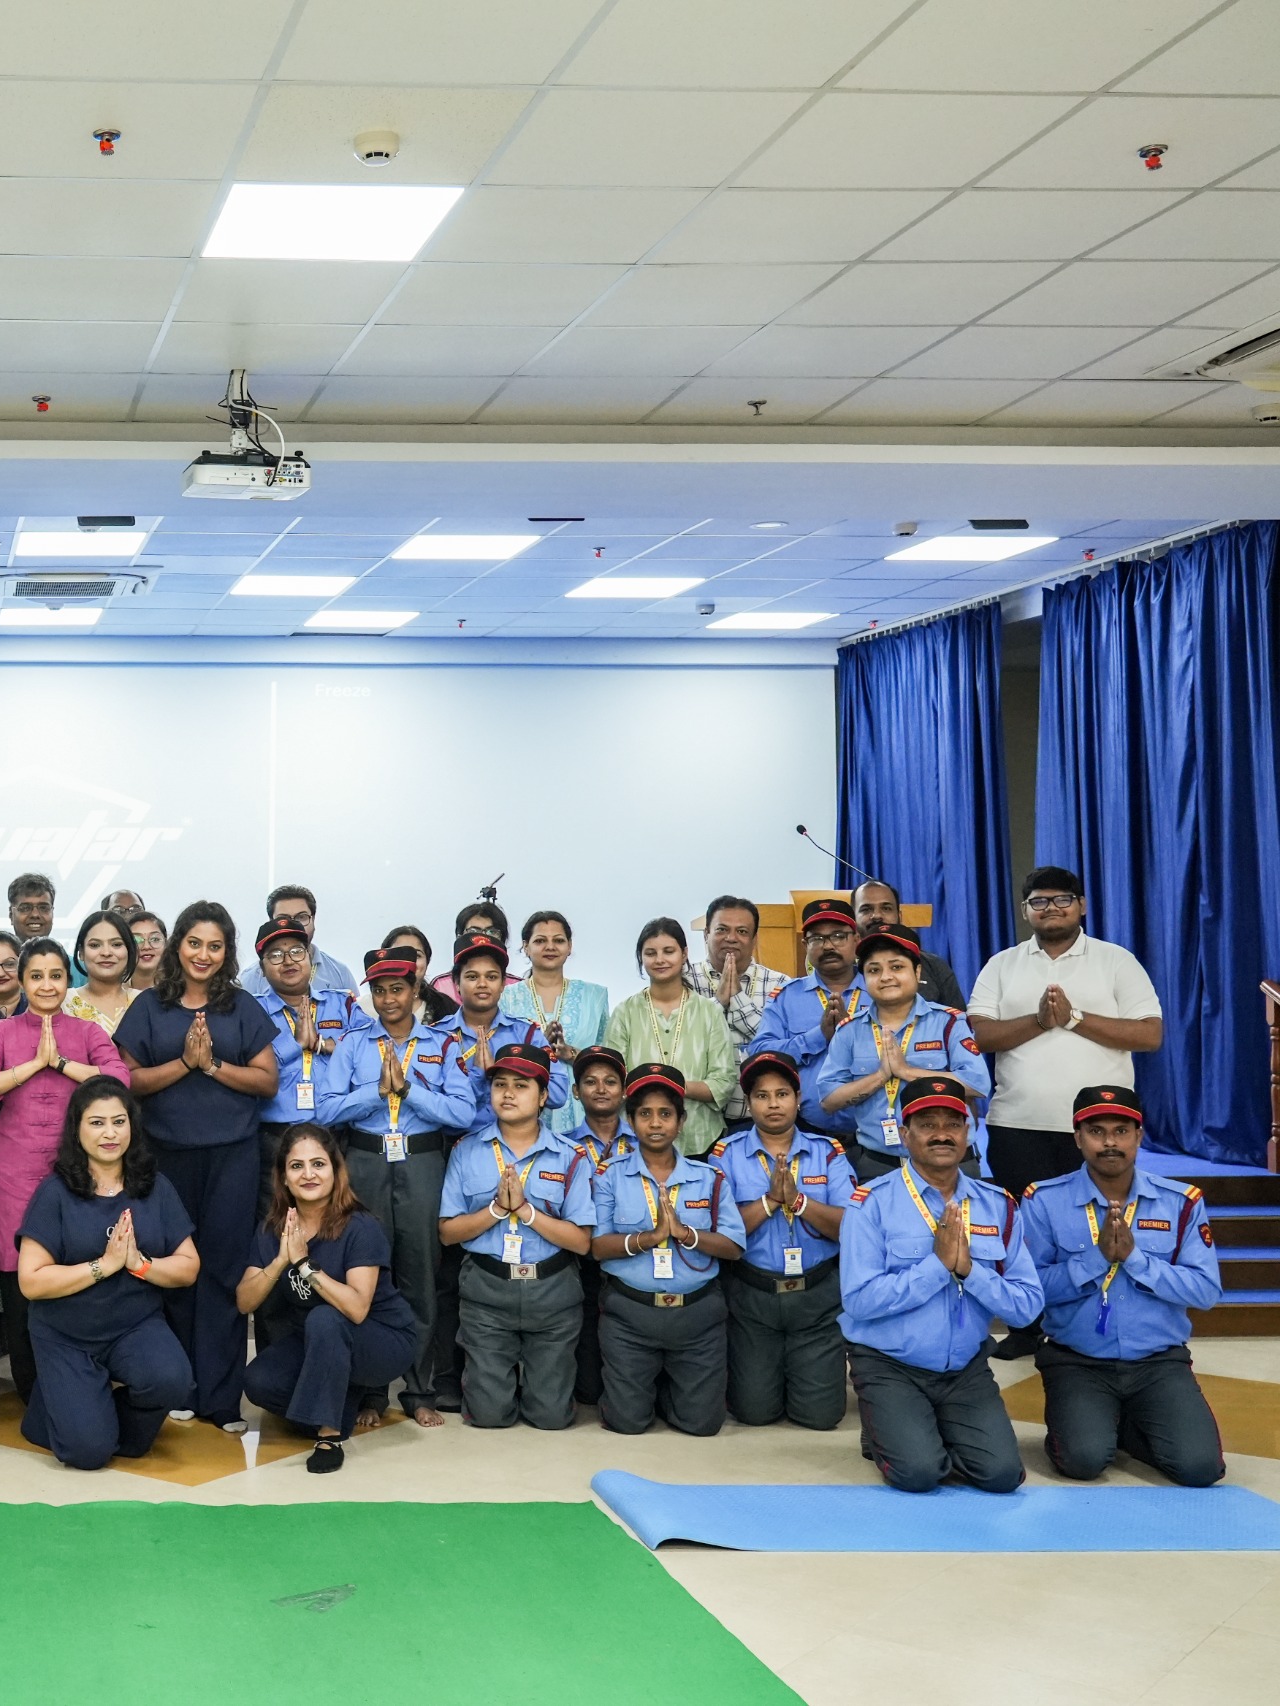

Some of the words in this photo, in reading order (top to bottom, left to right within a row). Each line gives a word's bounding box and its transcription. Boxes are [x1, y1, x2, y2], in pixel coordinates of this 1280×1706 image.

[314, 683, 372, 698] Freeze
[319, 1020, 341, 1028] PREMIER
[915, 1042, 941, 1050] PREMIER
[540, 1172, 565, 1181] PREMIER
[686, 1199, 709, 1207] PREMIER
[1138, 1220, 1169, 1230] PREMIER
[970, 1225, 998, 1235] PREMIER
